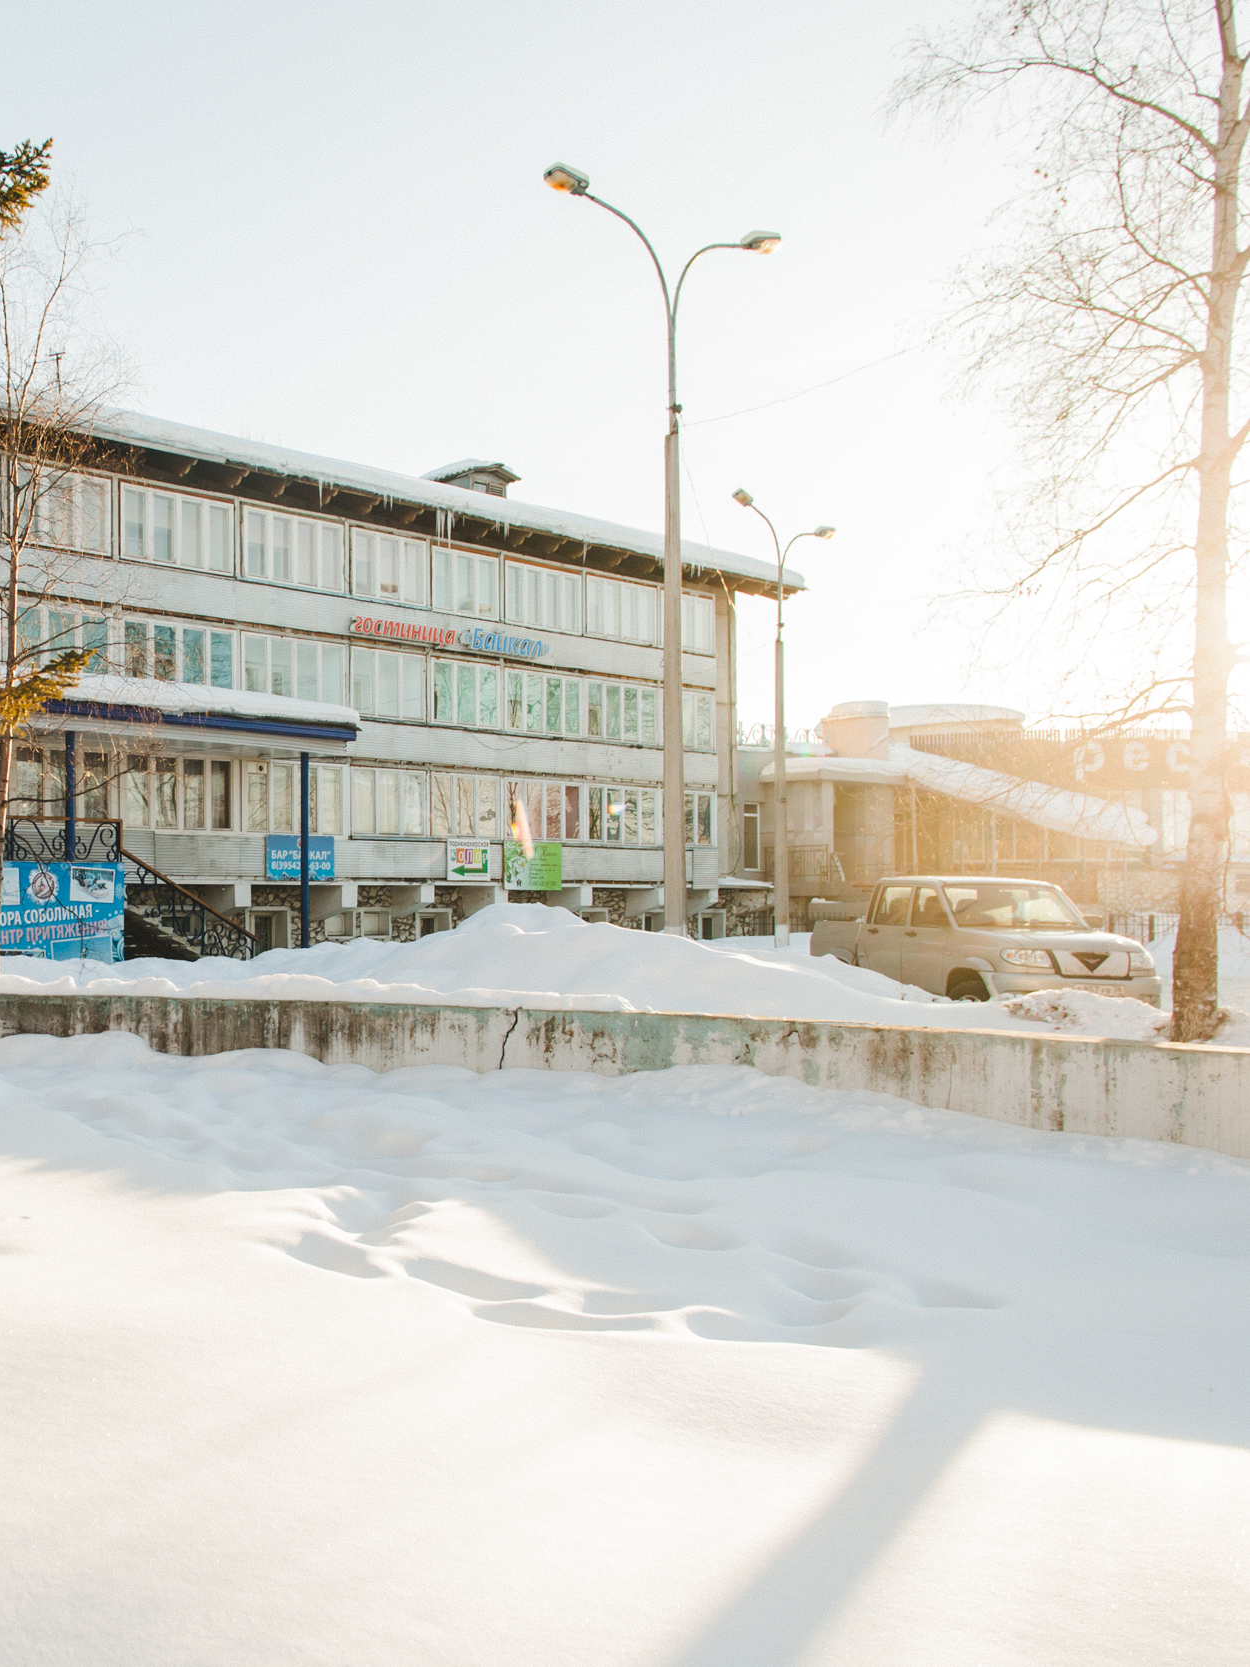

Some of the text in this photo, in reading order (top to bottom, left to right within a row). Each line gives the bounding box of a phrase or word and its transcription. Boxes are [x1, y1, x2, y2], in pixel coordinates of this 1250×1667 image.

[353, 615, 551, 658] гостиница «Байкал»
[271, 849, 331, 860] БАР “БКАЛ”
[0, 909, 23, 928] ОРА
[23, 903, 94, 925] СОБОЛИНАЯ
